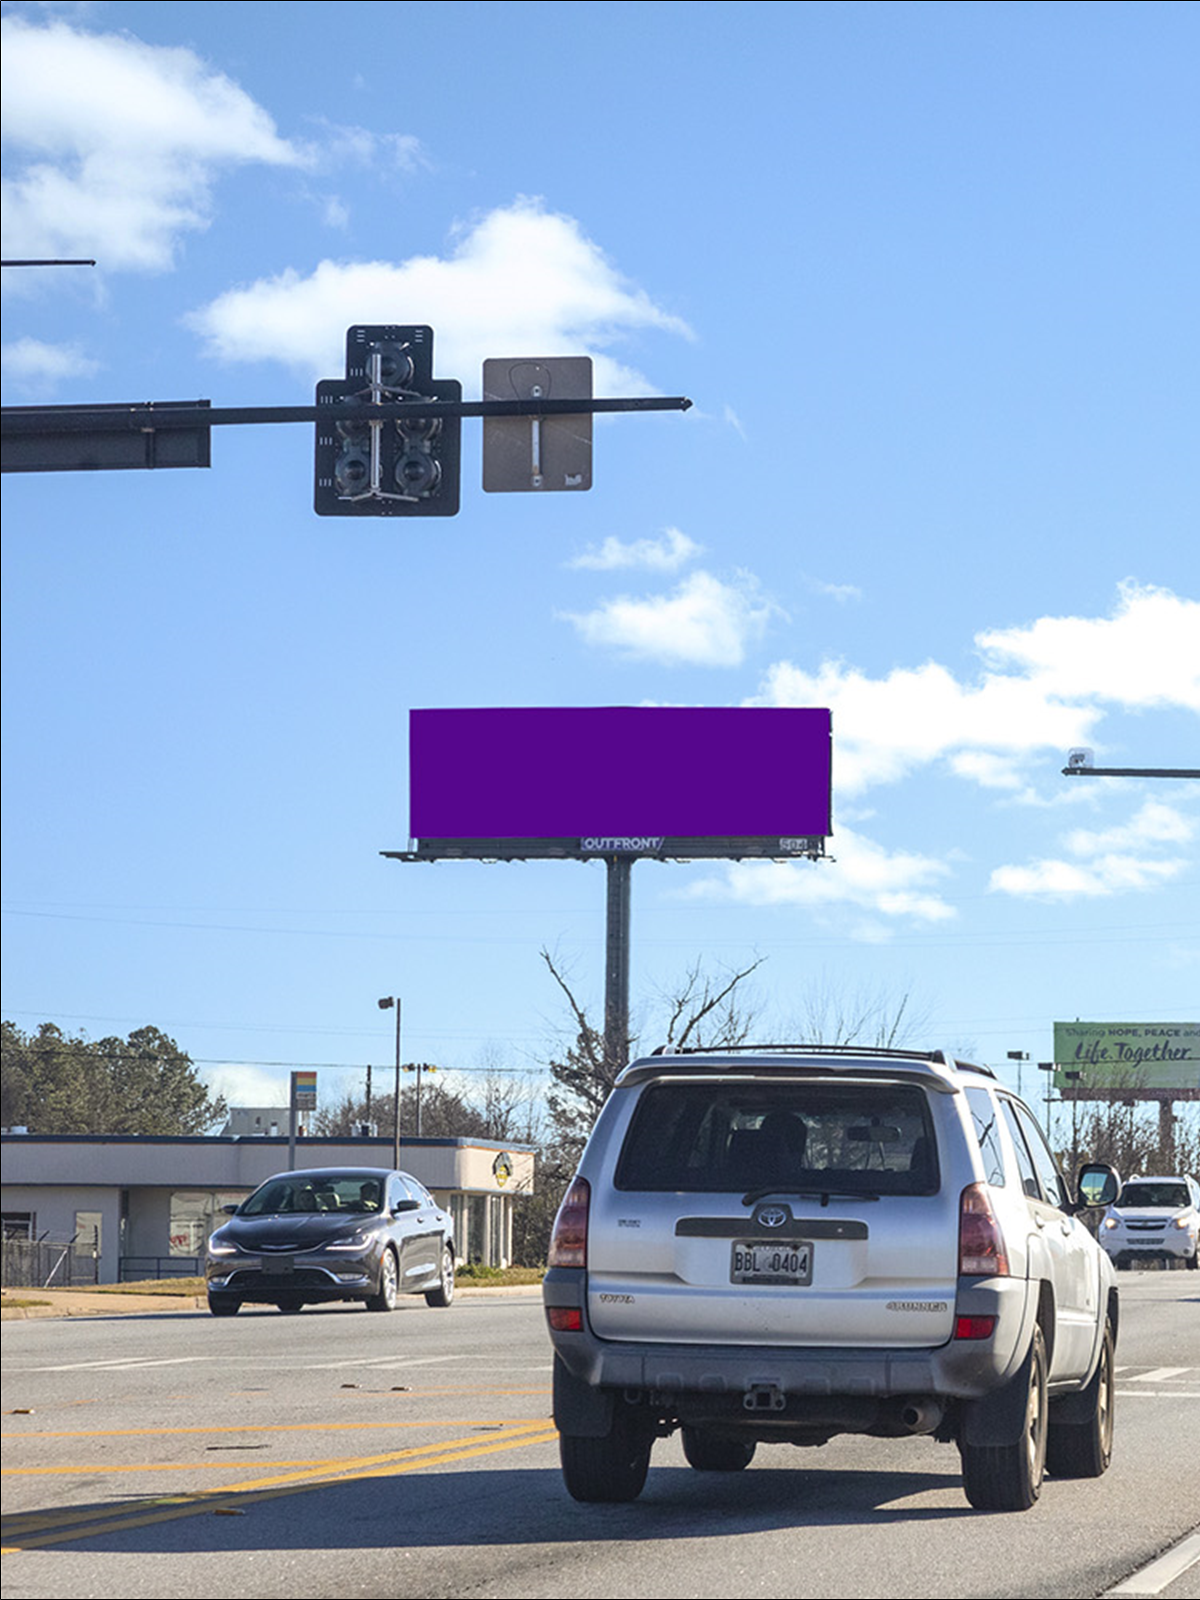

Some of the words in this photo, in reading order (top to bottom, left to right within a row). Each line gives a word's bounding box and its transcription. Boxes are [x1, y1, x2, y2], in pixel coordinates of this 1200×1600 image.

[1065, 1027, 1105, 1038] Sharing
[1108, 1028, 1142, 1038] HOPE,
[1145, 1028, 1181, 1037] PEACE
[735, 1252, 761, 1272] BBL
[772, 1252, 808, 1273] 0404
